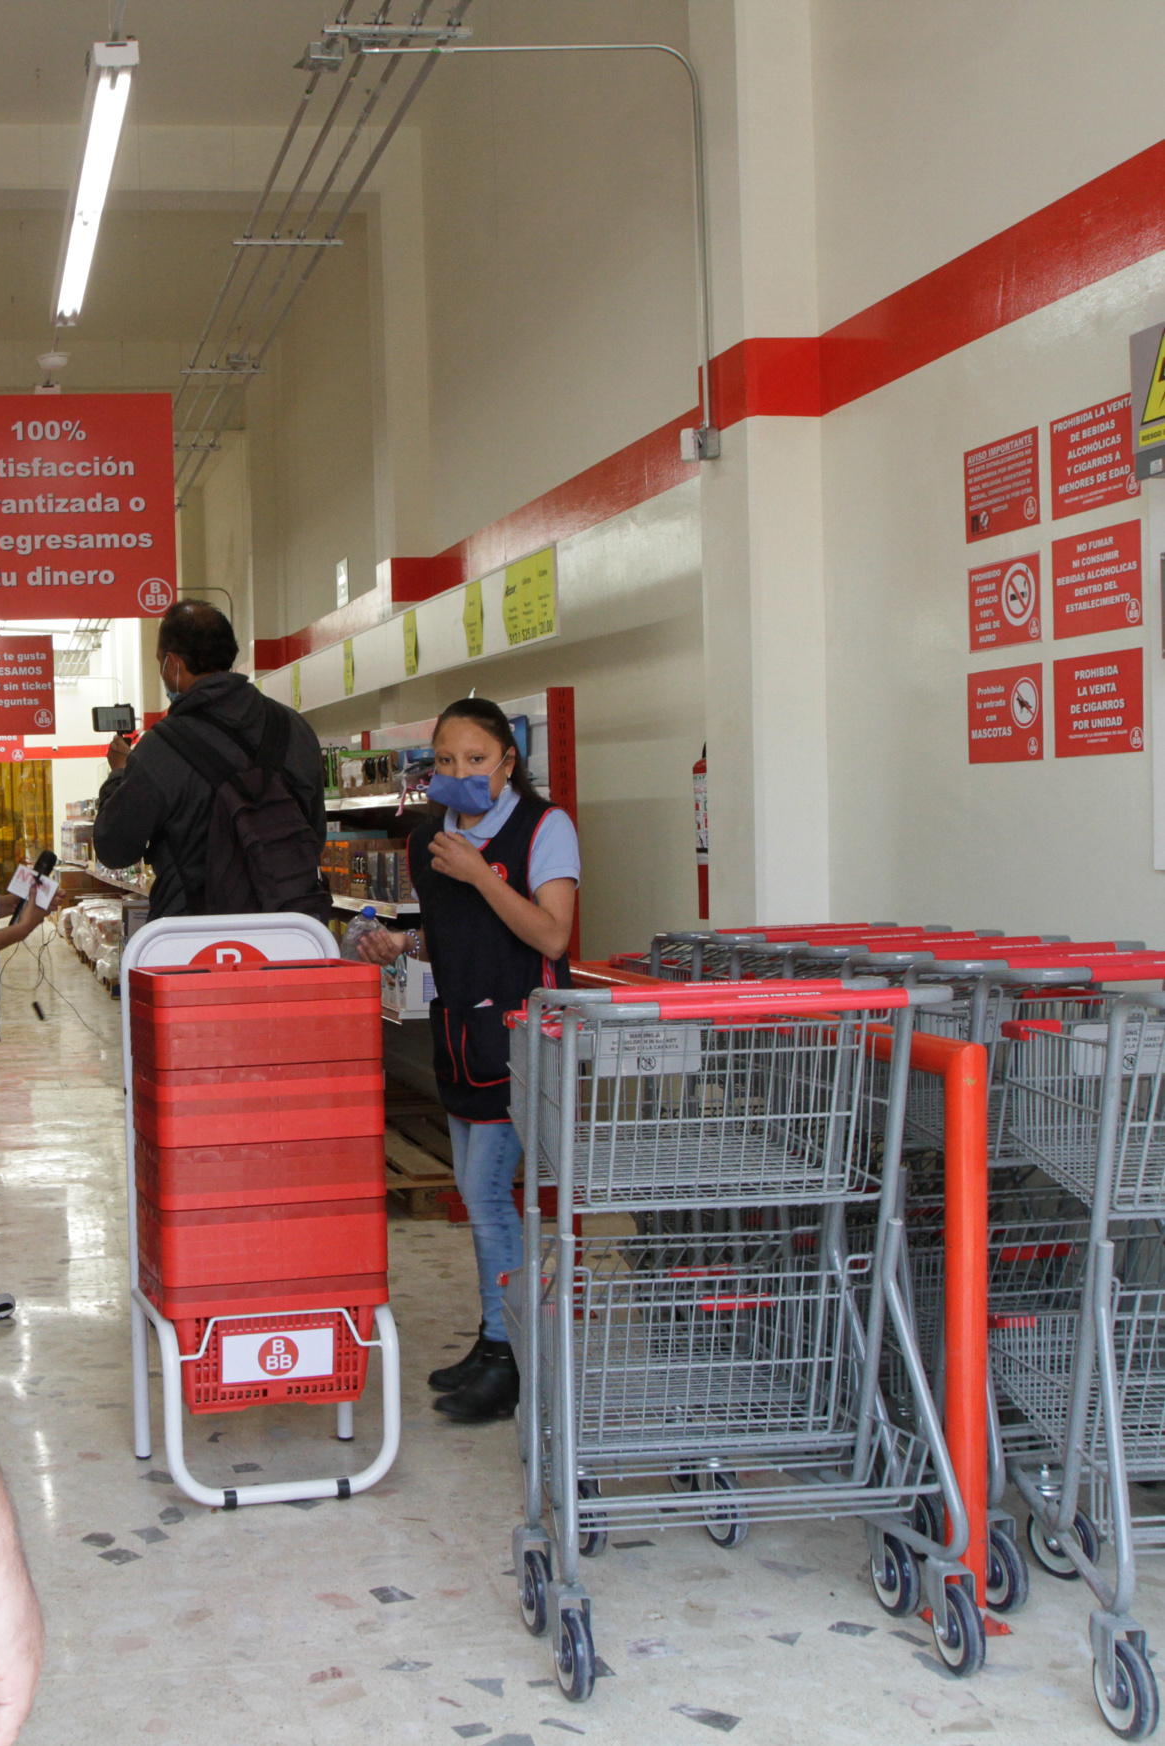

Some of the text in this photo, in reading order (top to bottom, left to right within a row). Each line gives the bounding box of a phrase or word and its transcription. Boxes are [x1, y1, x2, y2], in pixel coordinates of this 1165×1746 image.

[1053, 411, 1093, 433] PROHIBIDA
[1095, 406, 1106, 419] LA
[11, 420, 86, 441] 100%
[1070, 419, 1116, 443] DE BEBIDAS
[1141, 430, 1162, 442] RIESGO
[967, 433, 1033, 465] AVISO IMPORTANTE
[1067, 434, 1122, 460] ALCOHÓLICAS
[1067, 451, 1121, 476] Y CIGARROS A
[1058, 476, 1095, 495] MENORES
[1096, 471, 1107, 483] DE
[1108, 464, 1131, 479] EDAD
[129, 496, 146, 512] o
[1077, 536, 1114, 553] NO FUMAR
[1072, 550, 1119, 568] NI CONSUMIR
[26, 566, 115, 586] dinero
[971, 569, 1001, 582] PROHIBIDO
[1056, 573, 1085, 586] BEBIDAS
[977, 583, 996, 594] FUMAR
[1074, 580, 1118, 597] DENTRO DEL
[975, 595, 998, 607] ESPACIO
[1066, 593, 1130, 613] ESTABLECIMIENTO
[980, 609, 994, 618] 100%
[975, 620, 1001, 632] LIBRE DE
[979, 634, 996, 644] HUMO
[3, 652, 14, 661] te
[17, 652, 47, 662] gusta
[1074, 665, 1119, 681] PROHIBIDA
[3, 682, 19, 691] sin
[21, 681, 52, 690] ticket
[977, 685, 1005, 696] Prohibida
[1077, 682, 1117, 697] LA VENTA
[983, 698, 1006, 709] entrada
[1070, 698, 1125, 714] DE CIGARROS
[1073, 716, 1123, 730] POR UNIDAD
[971, 726, 1013, 740] MASCOTAS
[399, 856, 410, 900] STYLUS
